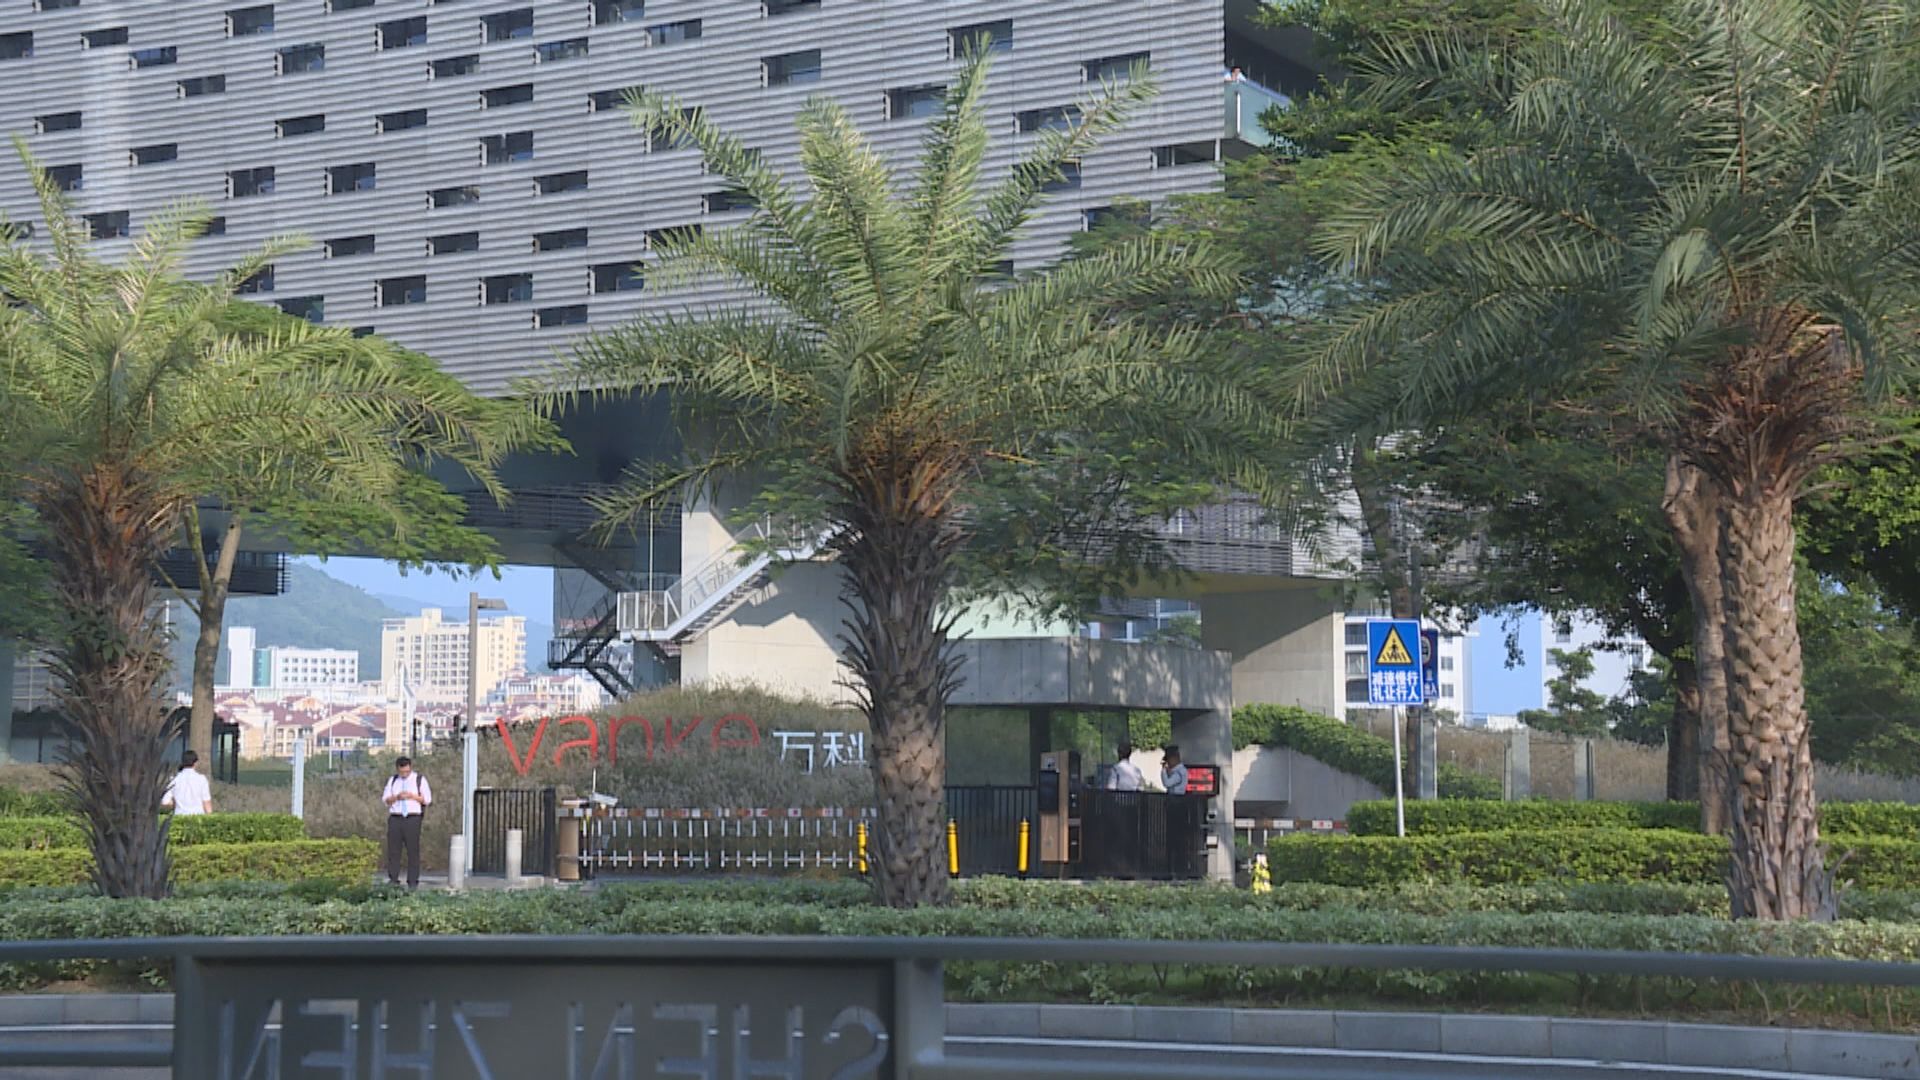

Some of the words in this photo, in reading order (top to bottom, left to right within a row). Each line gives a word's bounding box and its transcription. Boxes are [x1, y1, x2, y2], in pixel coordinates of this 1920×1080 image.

[1372, 670, 1418, 687] 减速慢行
[1373, 685, 1419, 702] 礼让行人
[772, 731, 869, 775] 万科
